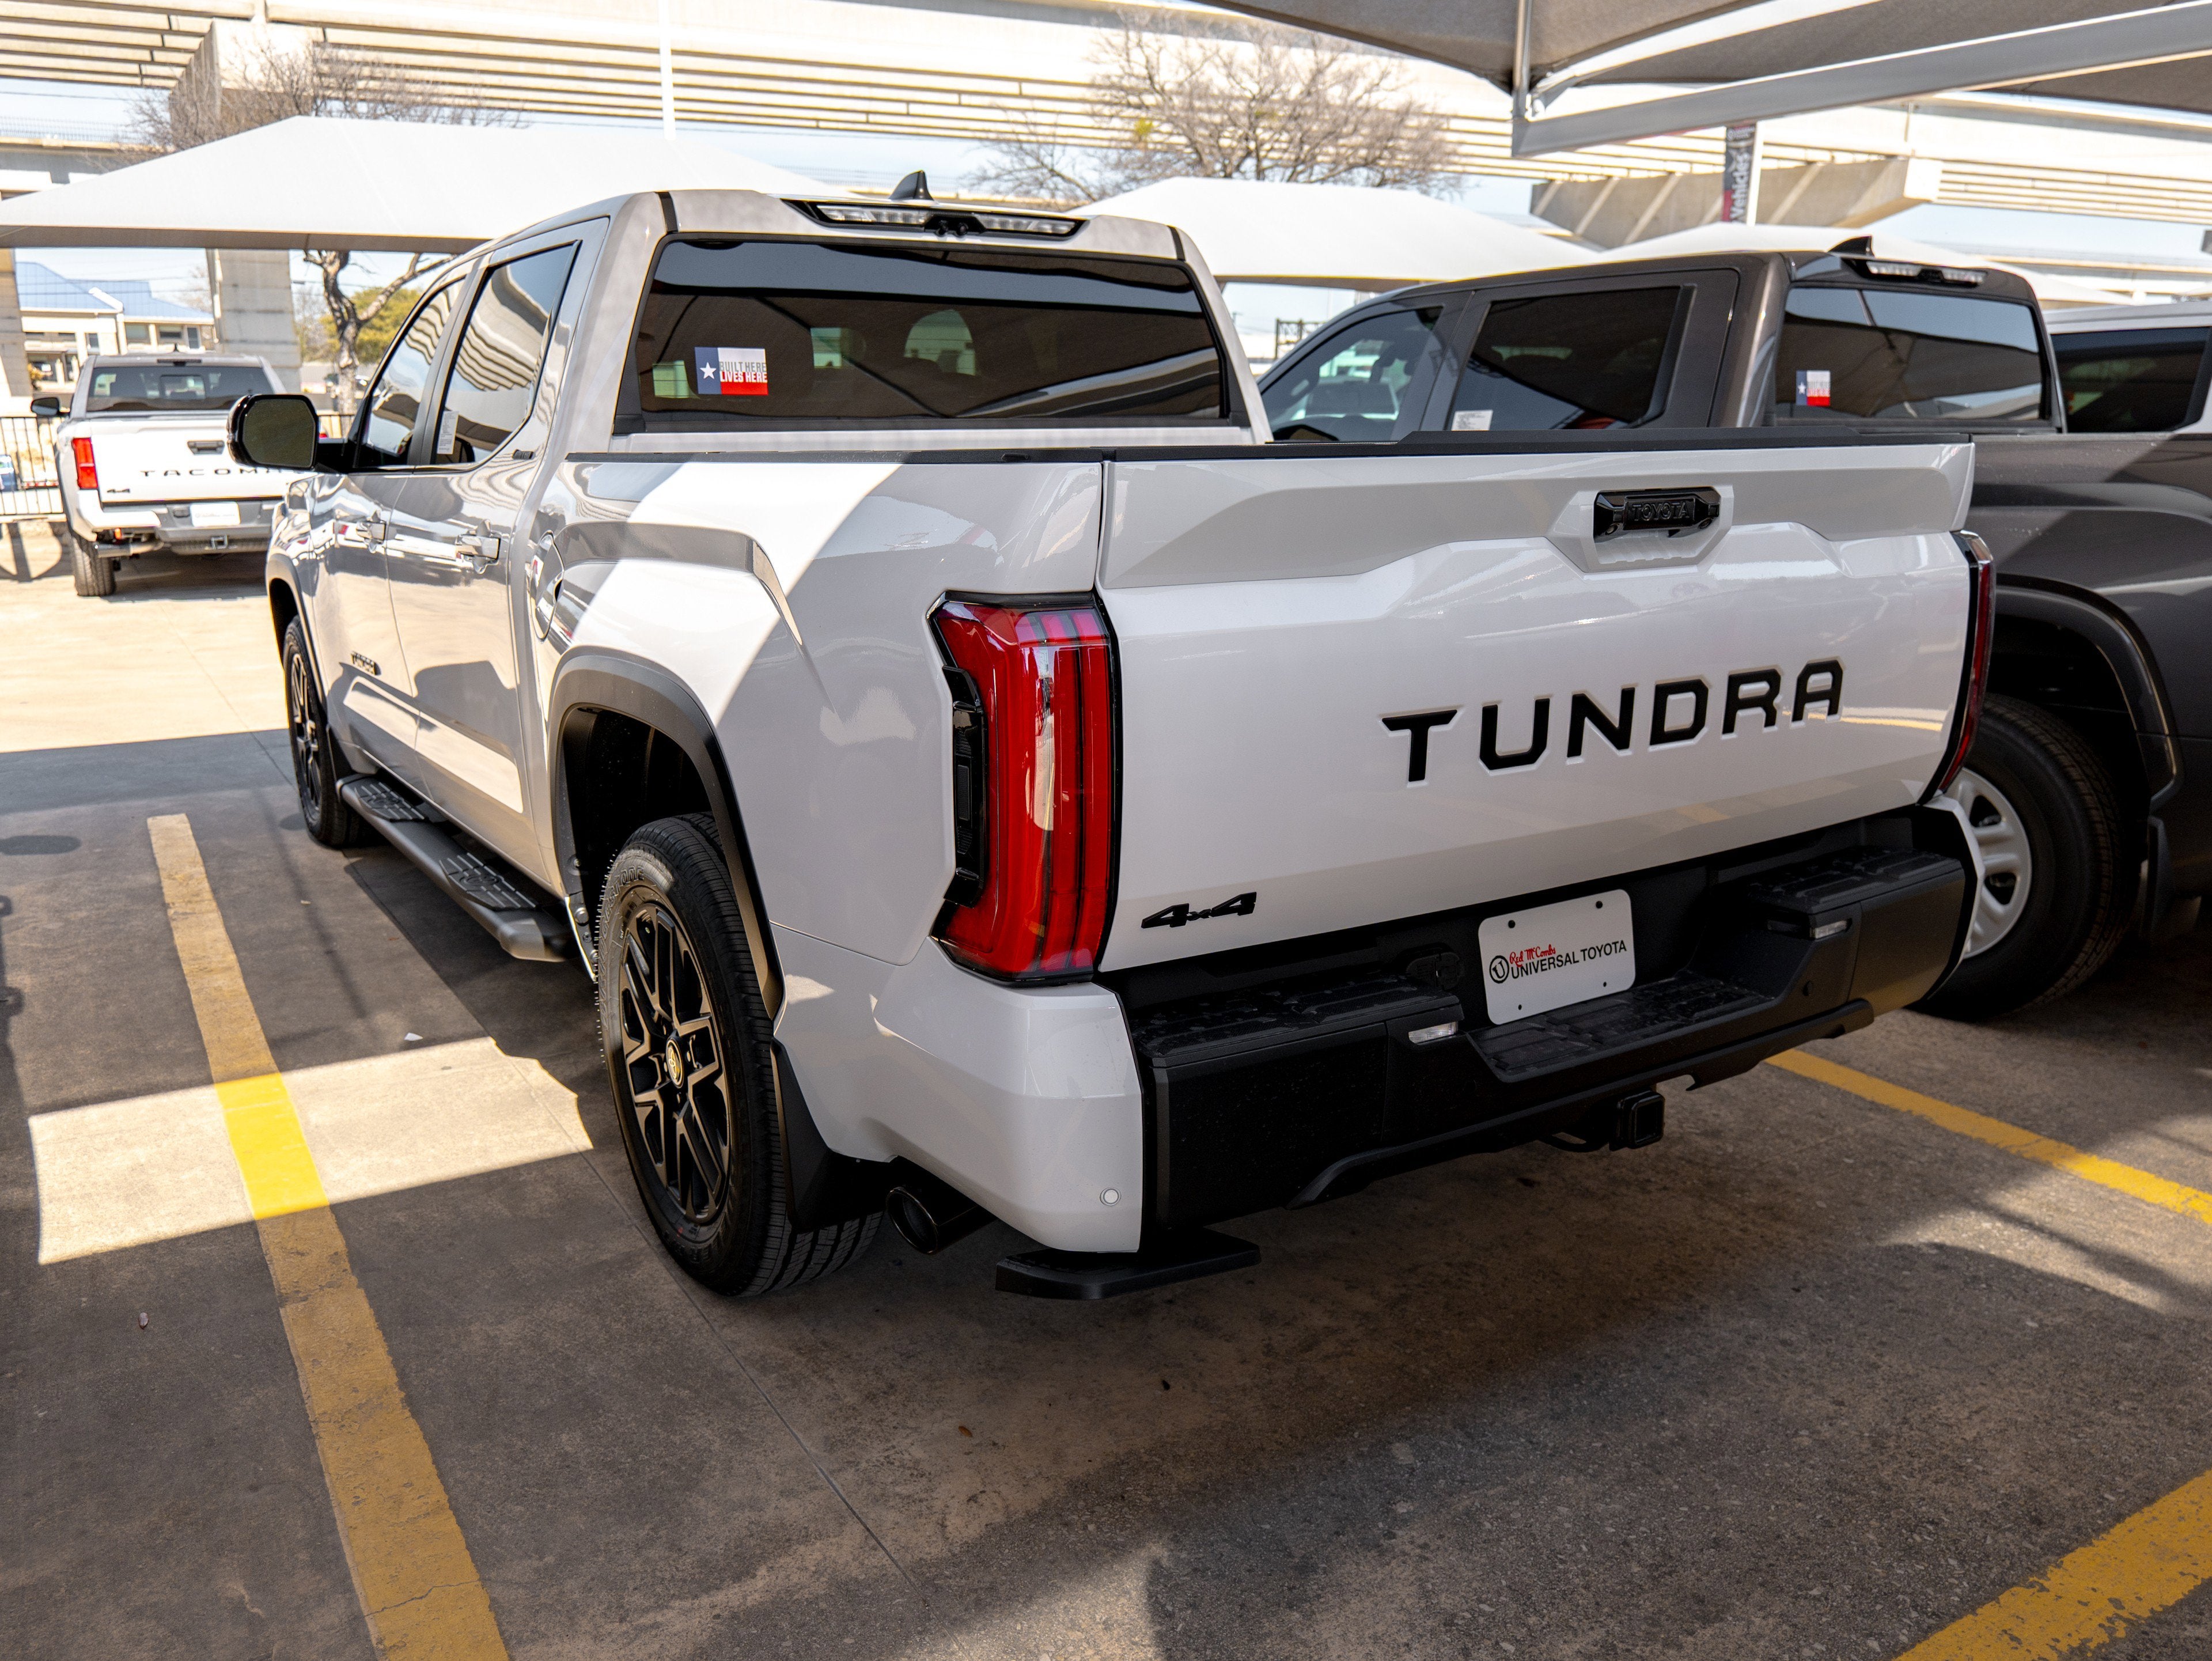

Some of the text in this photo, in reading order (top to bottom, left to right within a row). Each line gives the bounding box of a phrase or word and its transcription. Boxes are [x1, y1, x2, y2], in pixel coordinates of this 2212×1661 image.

[719, 362, 767, 372] BUILT HERE
[720, 371, 767, 383] LIVES HERE
[1632, 501, 1690, 521] TOYOTA
[1382, 660, 1843, 783] TUNDRA
[1141, 892, 1257, 929] 4x4
[1510, 944, 1556, 967] Red McCombs
[1511, 940, 1627, 979] UNIVERSAL TOYOTA
